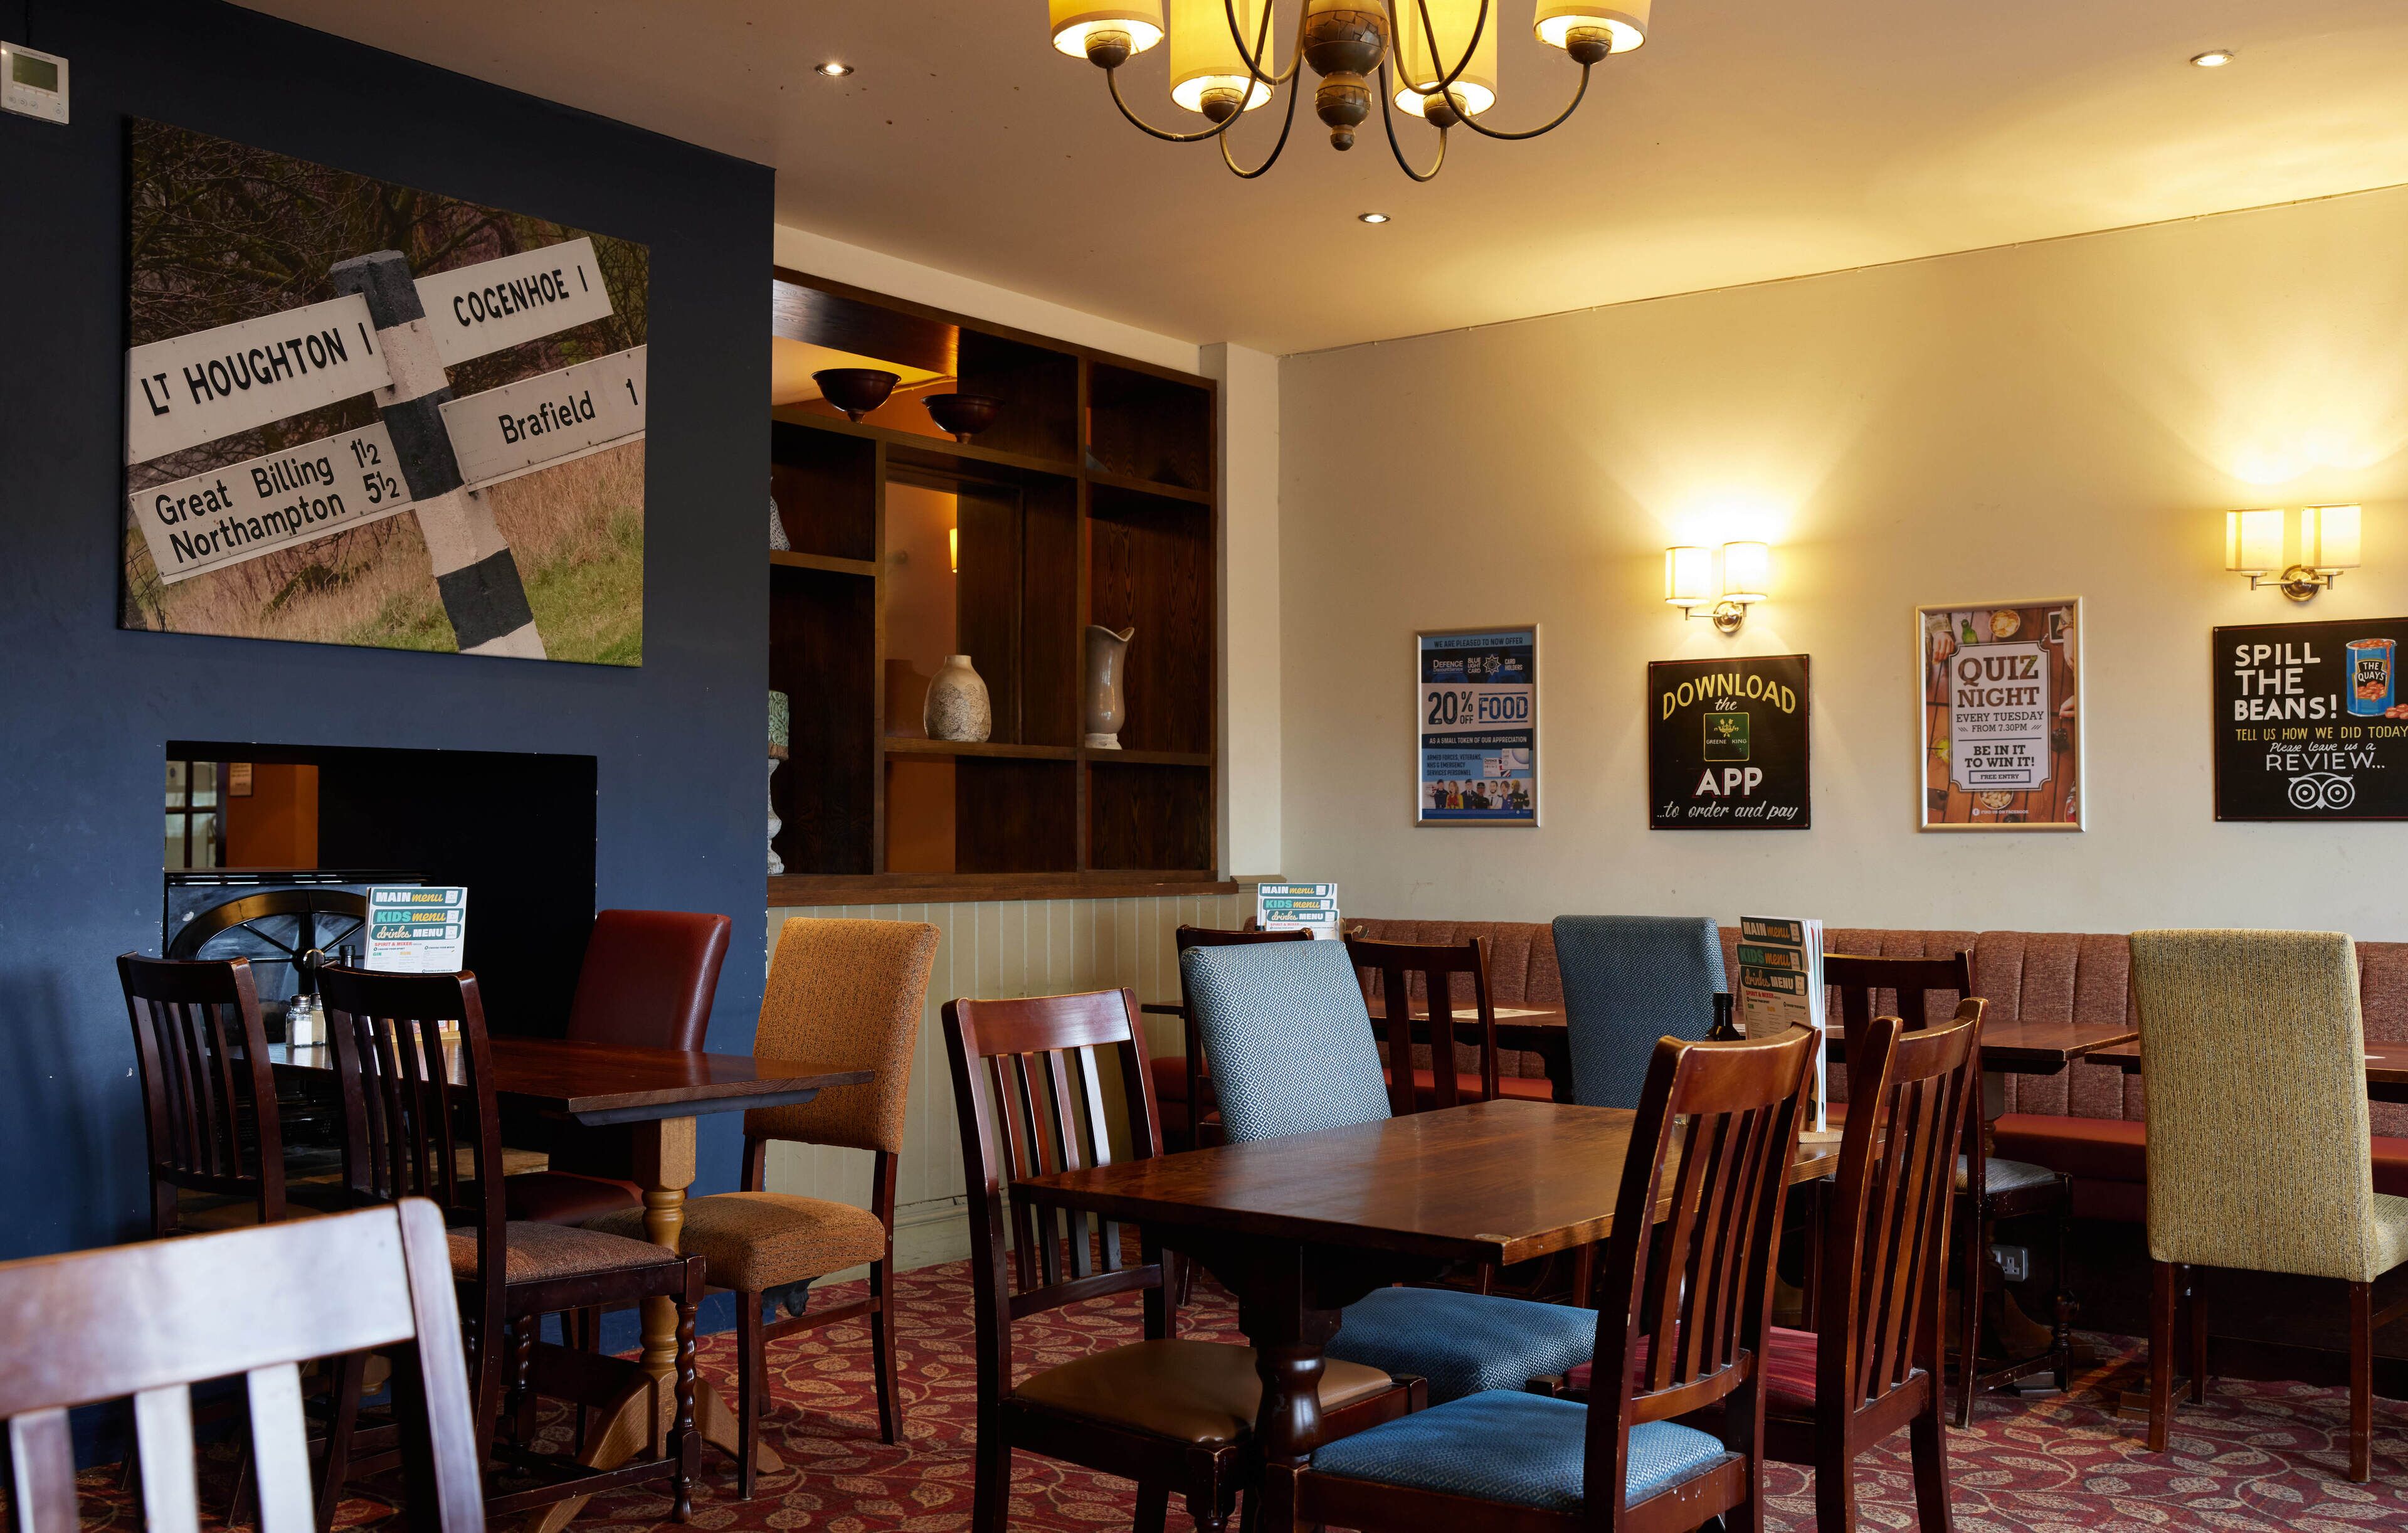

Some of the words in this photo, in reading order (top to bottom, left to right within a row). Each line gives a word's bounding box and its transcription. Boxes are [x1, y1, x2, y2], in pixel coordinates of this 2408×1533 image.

[453, 268, 569, 327] COGENHOE
[182, 327, 348, 405] HOUGHTON
[498, 390, 596, 445] Brafield
[625, 378, 638, 406] 1
[155, 479, 233, 526] Great
[251, 456, 334, 499] Billing
[169, 493, 346, 563] Northampton
[1456, 639, 1481, 647] PLEASED
[1505, 637, 1523, 645] OFFER
[2234, 642, 2321, 667] SPILL
[1958, 654, 2039, 687] QUIZ
[2362, 662, 2379, 671] THE
[2234, 667, 2305, 696] THE
[2357, 671, 2385, 682] QUAYS
[1664, 673, 1795, 720] DOWNLOAD
[1715, 697, 1737, 711] the
[1957, 687, 2040, 708] NIGHT
[1460, 714, 1474, 724] OFF
[1479, 696, 1528, 719] FOOD
[1956, 714, 1990, 723] EVERY
[1993, 711, 2044, 721] TUESDAY
[2234, 694, 2337, 721] BEANS!
[1971, 724, 1996, 733] FROM
[1998, 723, 2027, 732] 7.30PM
[2236, 728, 2258, 741] TELL
[2263, 728, 2276, 741] US
[2282, 728, 2308, 740] HOW
[2315, 727, 2333, 739] WE
[2340, 726, 2362, 739] DID
[1973, 746, 1991, 756] BE
[1994, 745, 2009, 755] IN
[2012, 745, 2026, 755] IT
[2269, 742, 2302, 753] Please
[2308, 741, 2338, 751] leave
[2344, 743, 2358, 751] us
[2365, 743, 2377, 751] a
[1965, 758, 1983, 768] TO
[1987, 758, 2014, 768] WIN
[2017, 756, 2035, 767] IT!
[2266, 752, 2385, 771] REVIEW...
[1695, 767, 1763, 796] APP
[1688, 800, 1729, 817] order
[1735, 800, 1766, 817] and
[1766, 807, 1798, 820] pay
[376, 892, 411, 903] MAIN
[411, 893, 443, 902] menu
[1265, 900, 1292, 908] KIDS
[377, 911, 411, 923] KIDS
[412, 913, 446, 922] menu
[1271, 911, 1298, 921] drinks
[377, 925, 411, 939] drinks
[413, 928, 443, 937] MENU
[1743, 922, 1767, 936] MAIN
[1766, 926, 1790, 938] menu
[1739, 947, 1765, 963] KIDS
[1765, 952, 1791, 966] menu
[1745, 968, 1771, 987] drinks
[1770, 976, 1794, 990] MENU
